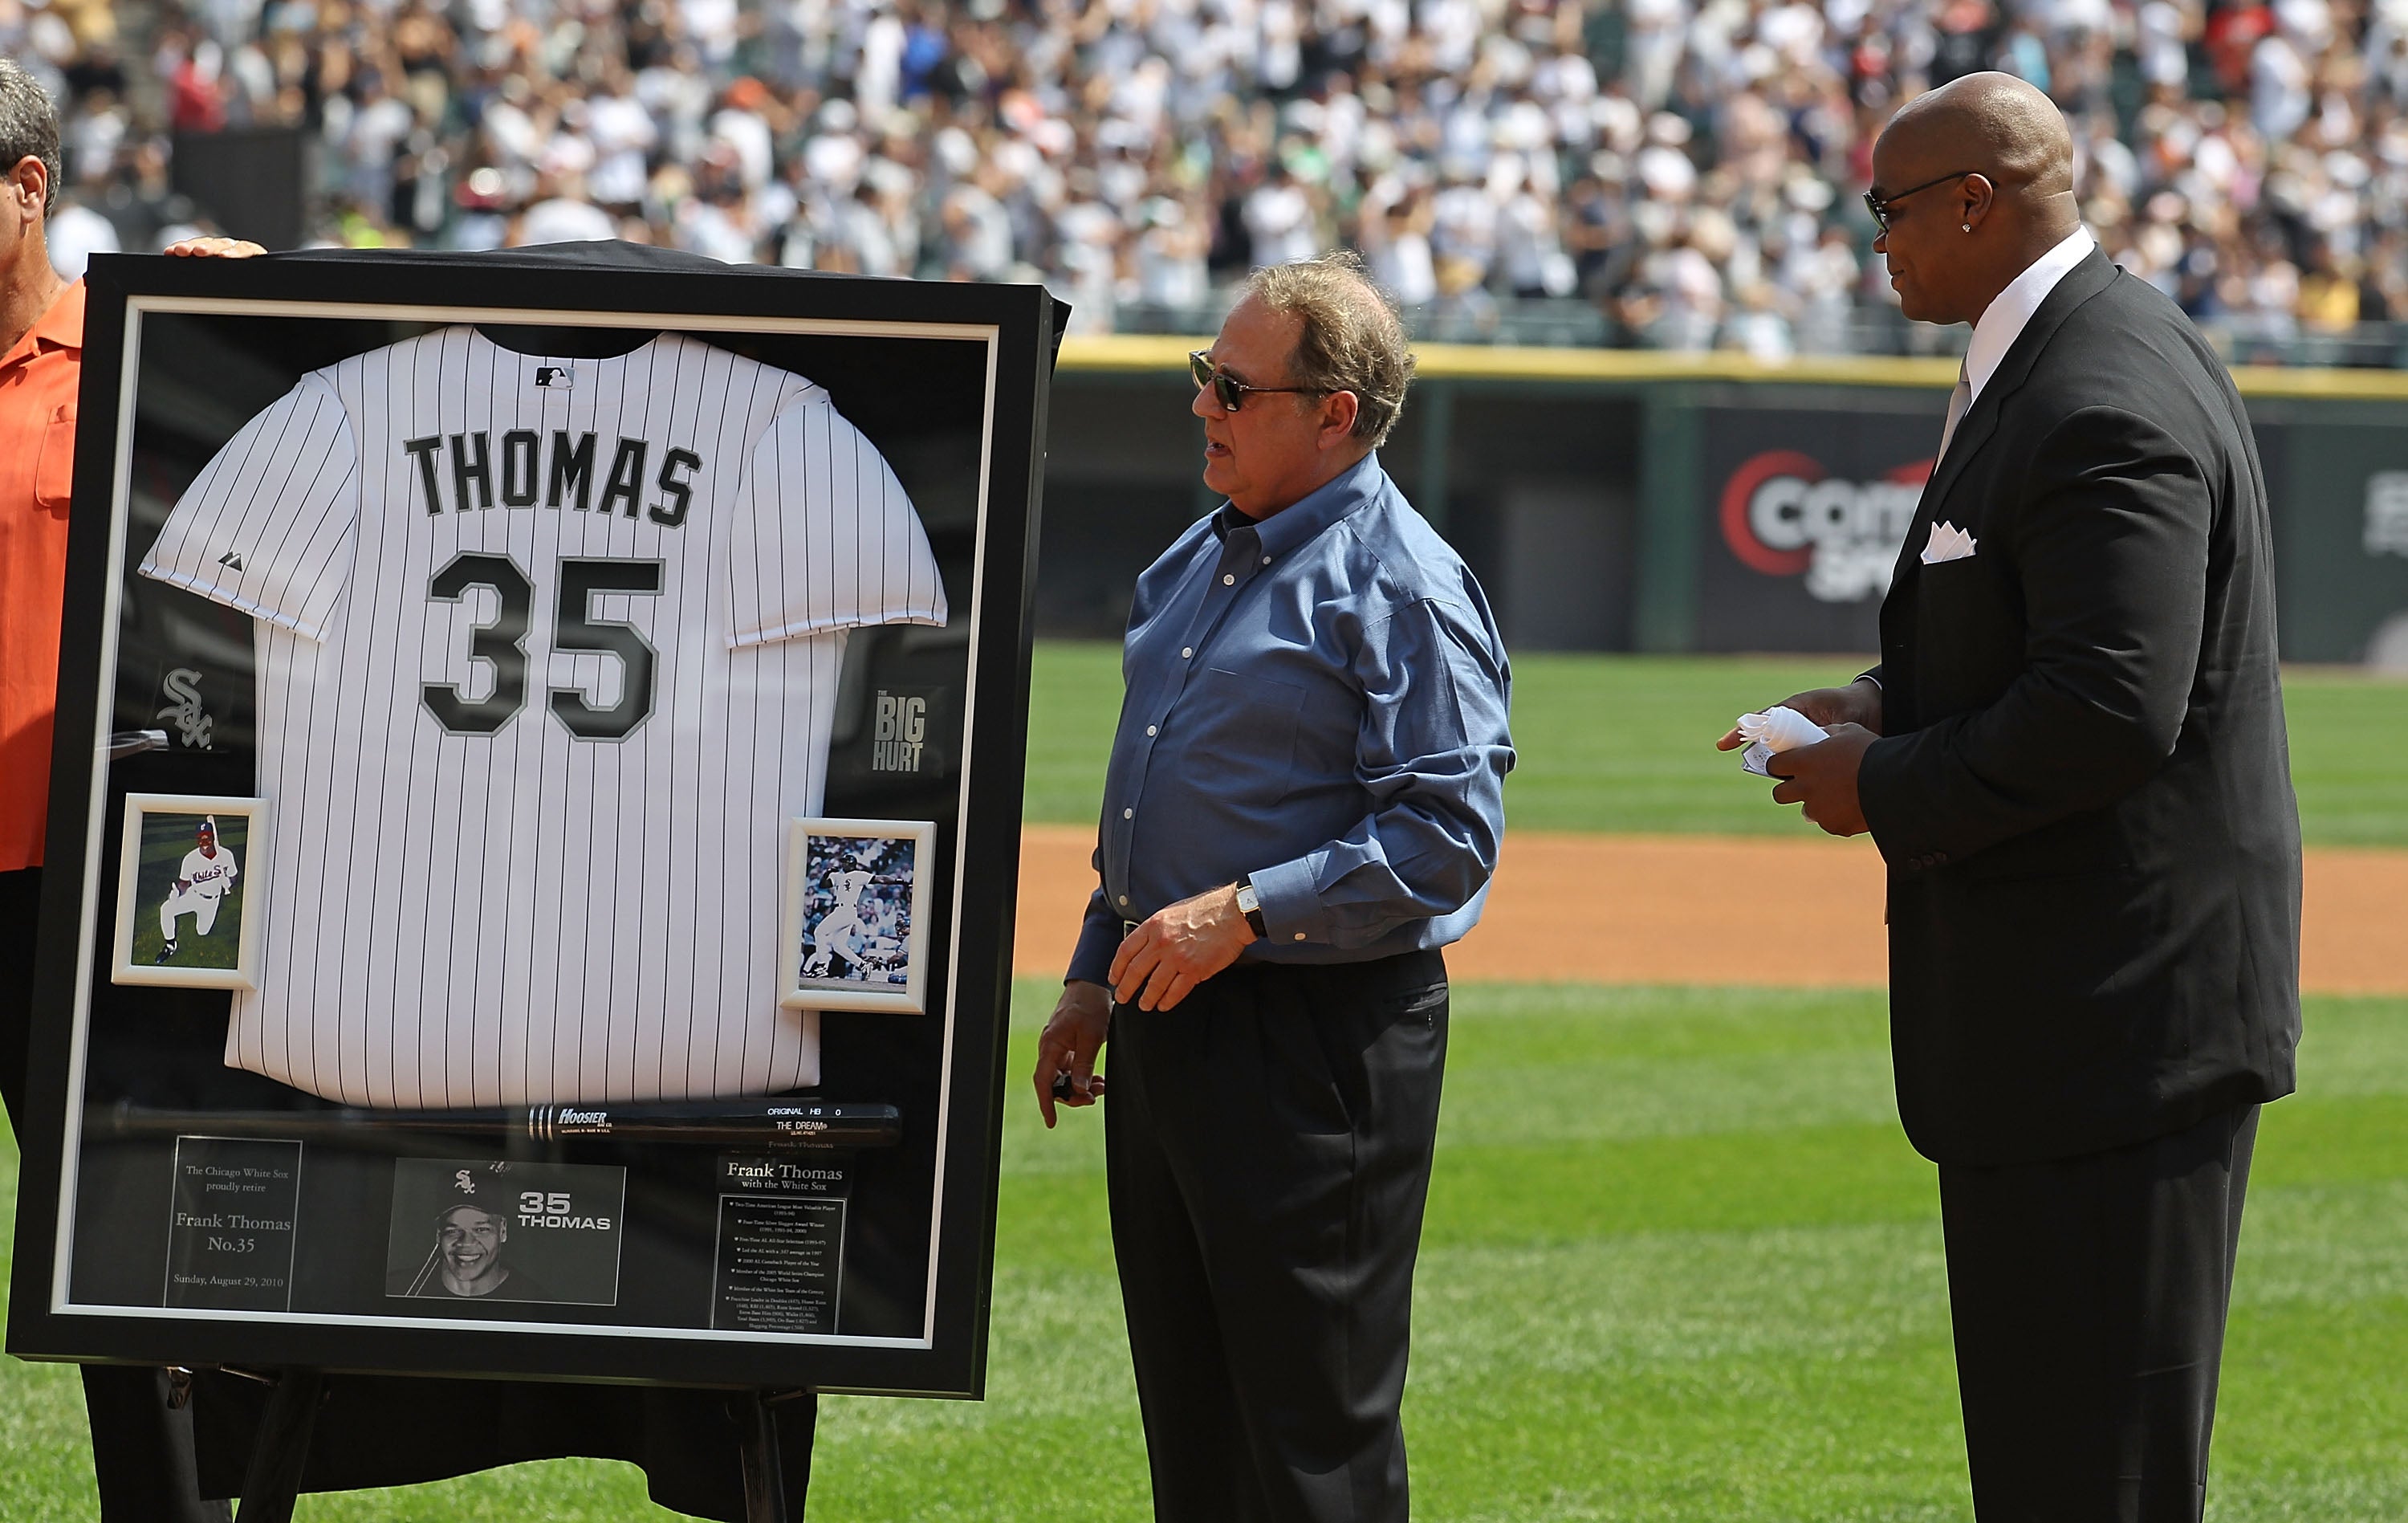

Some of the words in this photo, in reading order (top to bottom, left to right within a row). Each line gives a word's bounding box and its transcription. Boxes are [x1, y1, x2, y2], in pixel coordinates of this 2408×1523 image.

[403, 429, 703, 529] THOMAS
[419, 551, 666, 743] 35
[157, 668, 214, 748] Sox
[875, 696, 925, 743] BIG
[872, 741, 923, 772] HURT
[558, 1108, 608, 1125] HOOSIER
[776, 1122, 792, 1130] THE
[186, 1165, 203, 1175] The
[205, 1167, 241, 1178] Chicago
[243, 1168, 271, 1178] White
[273, 1169, 289, 1179] Sox
[727, 1162, 775, 1177] Frank
[779, 1164, 843, 1180] Thomas
[205, 1182, 241, 1193] proudly
[242, 1183, 266, 1192] retire
[742, 1179, 762, 1188] with
[764, 1180, 779, 1189] the
[781, 1180, 809, 1190] White
[811, 1182, 827, 1191] Sox
[519, 1191, 571, 1214] 35
[175, 1212, 223, 1228] Frank
[227, 1215, 291, 1230] Thomas
[518, 1215, 611, 1230] THOMAS
[207, 1236, 255, 1252] No.35
[173, 1273, 207, 1285] Sunday,
[209, 1275, 242, 1287] August
[244, 1277, 258, 1287] 29,
[261, 1277, 283, 1287] 2010
